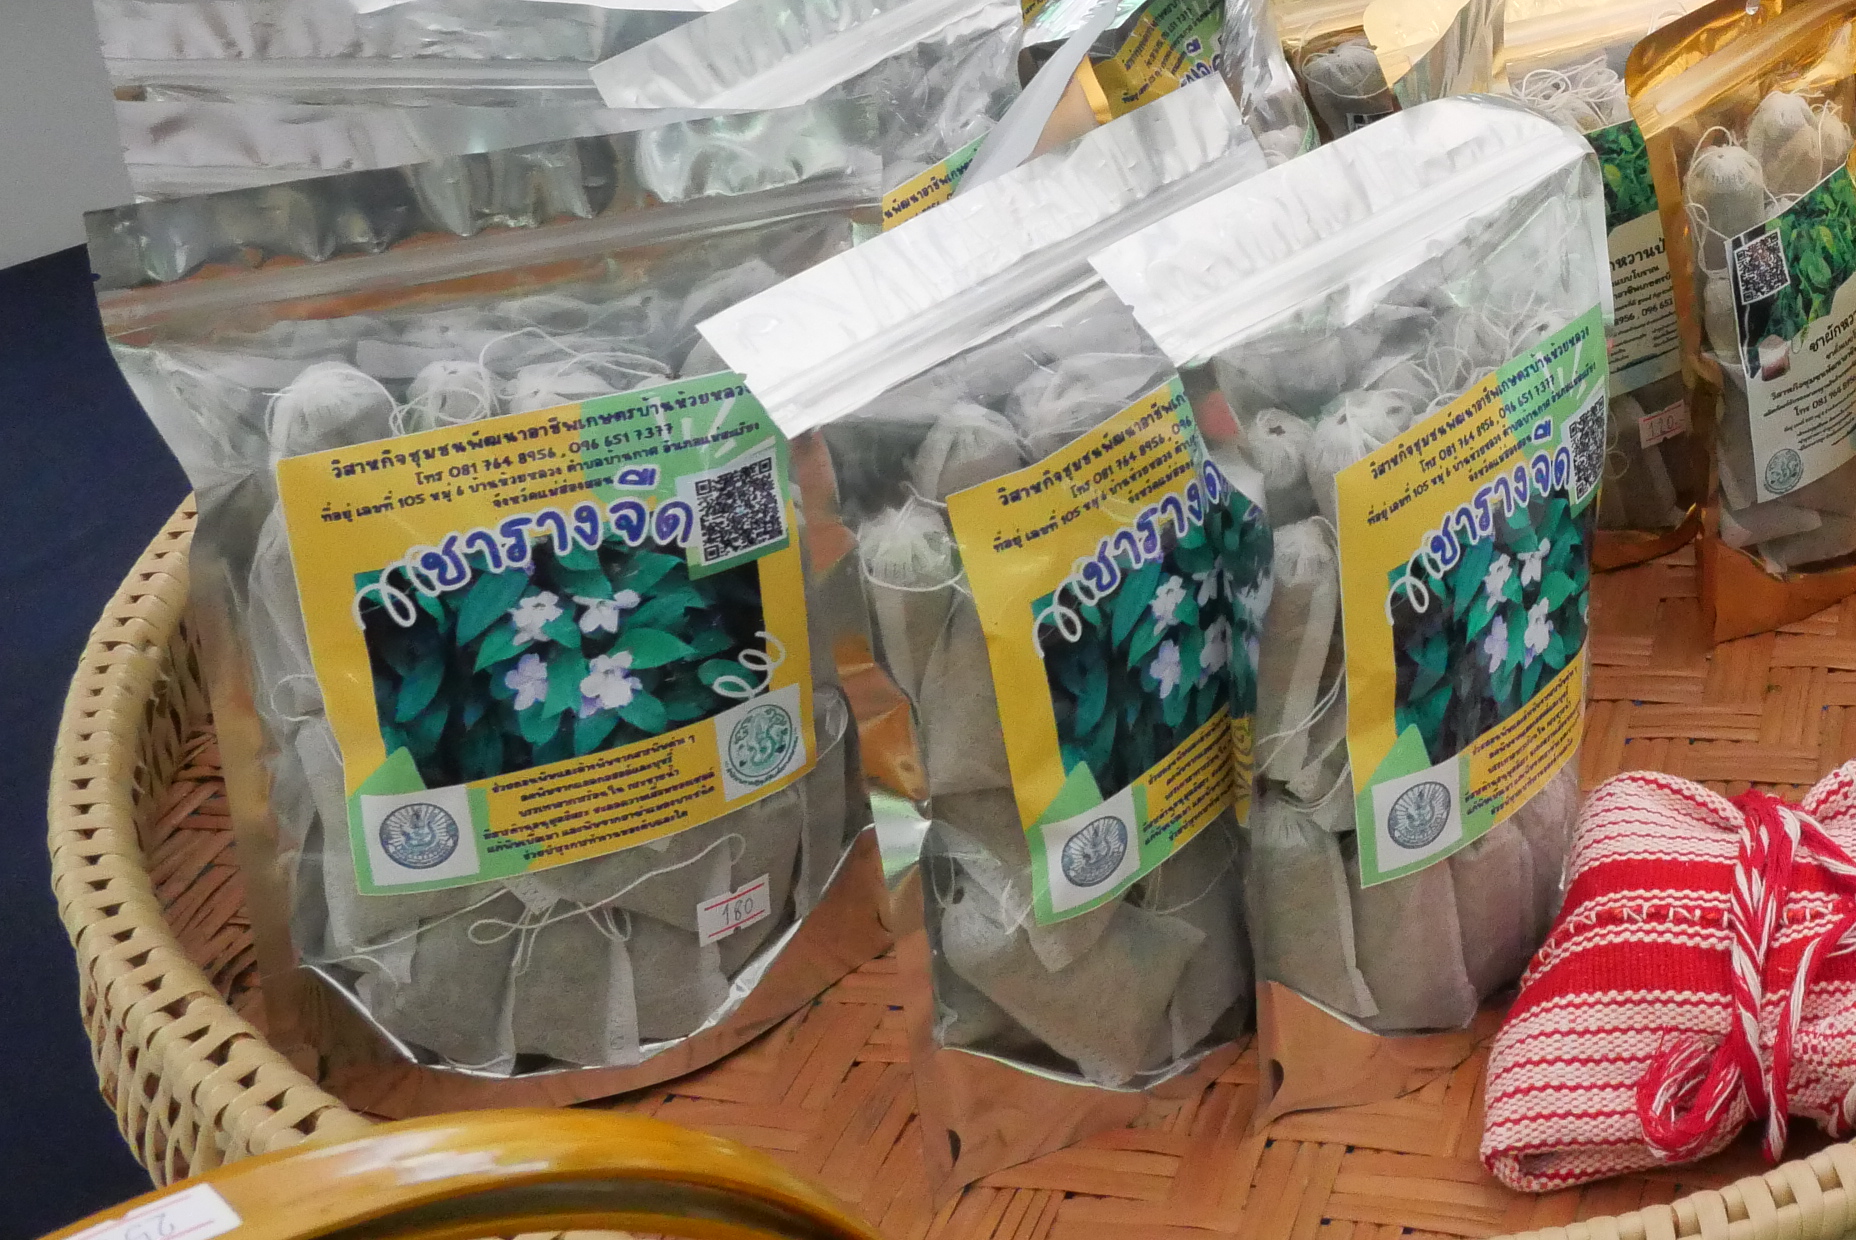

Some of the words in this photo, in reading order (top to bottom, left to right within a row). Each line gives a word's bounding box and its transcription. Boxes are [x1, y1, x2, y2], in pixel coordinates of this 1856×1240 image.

[1439, 443, 1456, 460] 081
[1476, 416, 1495, 437] 8956
[414, 471, 443, 486] โทร
[449, 462, 478, 478] 081
[482, 455, 514, 471] 764
[517, 447, 557, 464] 8956
[568, 439, 600, 453] 096
[604, 432, 630, 446] 651
[633, 423, 674, 440] 7377
[1093, 464, 1114, 484] 081
[398, 493, 425, 508] 105
[456, 485, 464, 497] 6
[1413, 480, 1429, 498] 105
[1430, 418, 1571, 566] ชารางจืด
[420, 467, 694, 588] ชารางจืด
[1061, 506, 1081, 525] 105
[722, 897, 754, 926] 180
